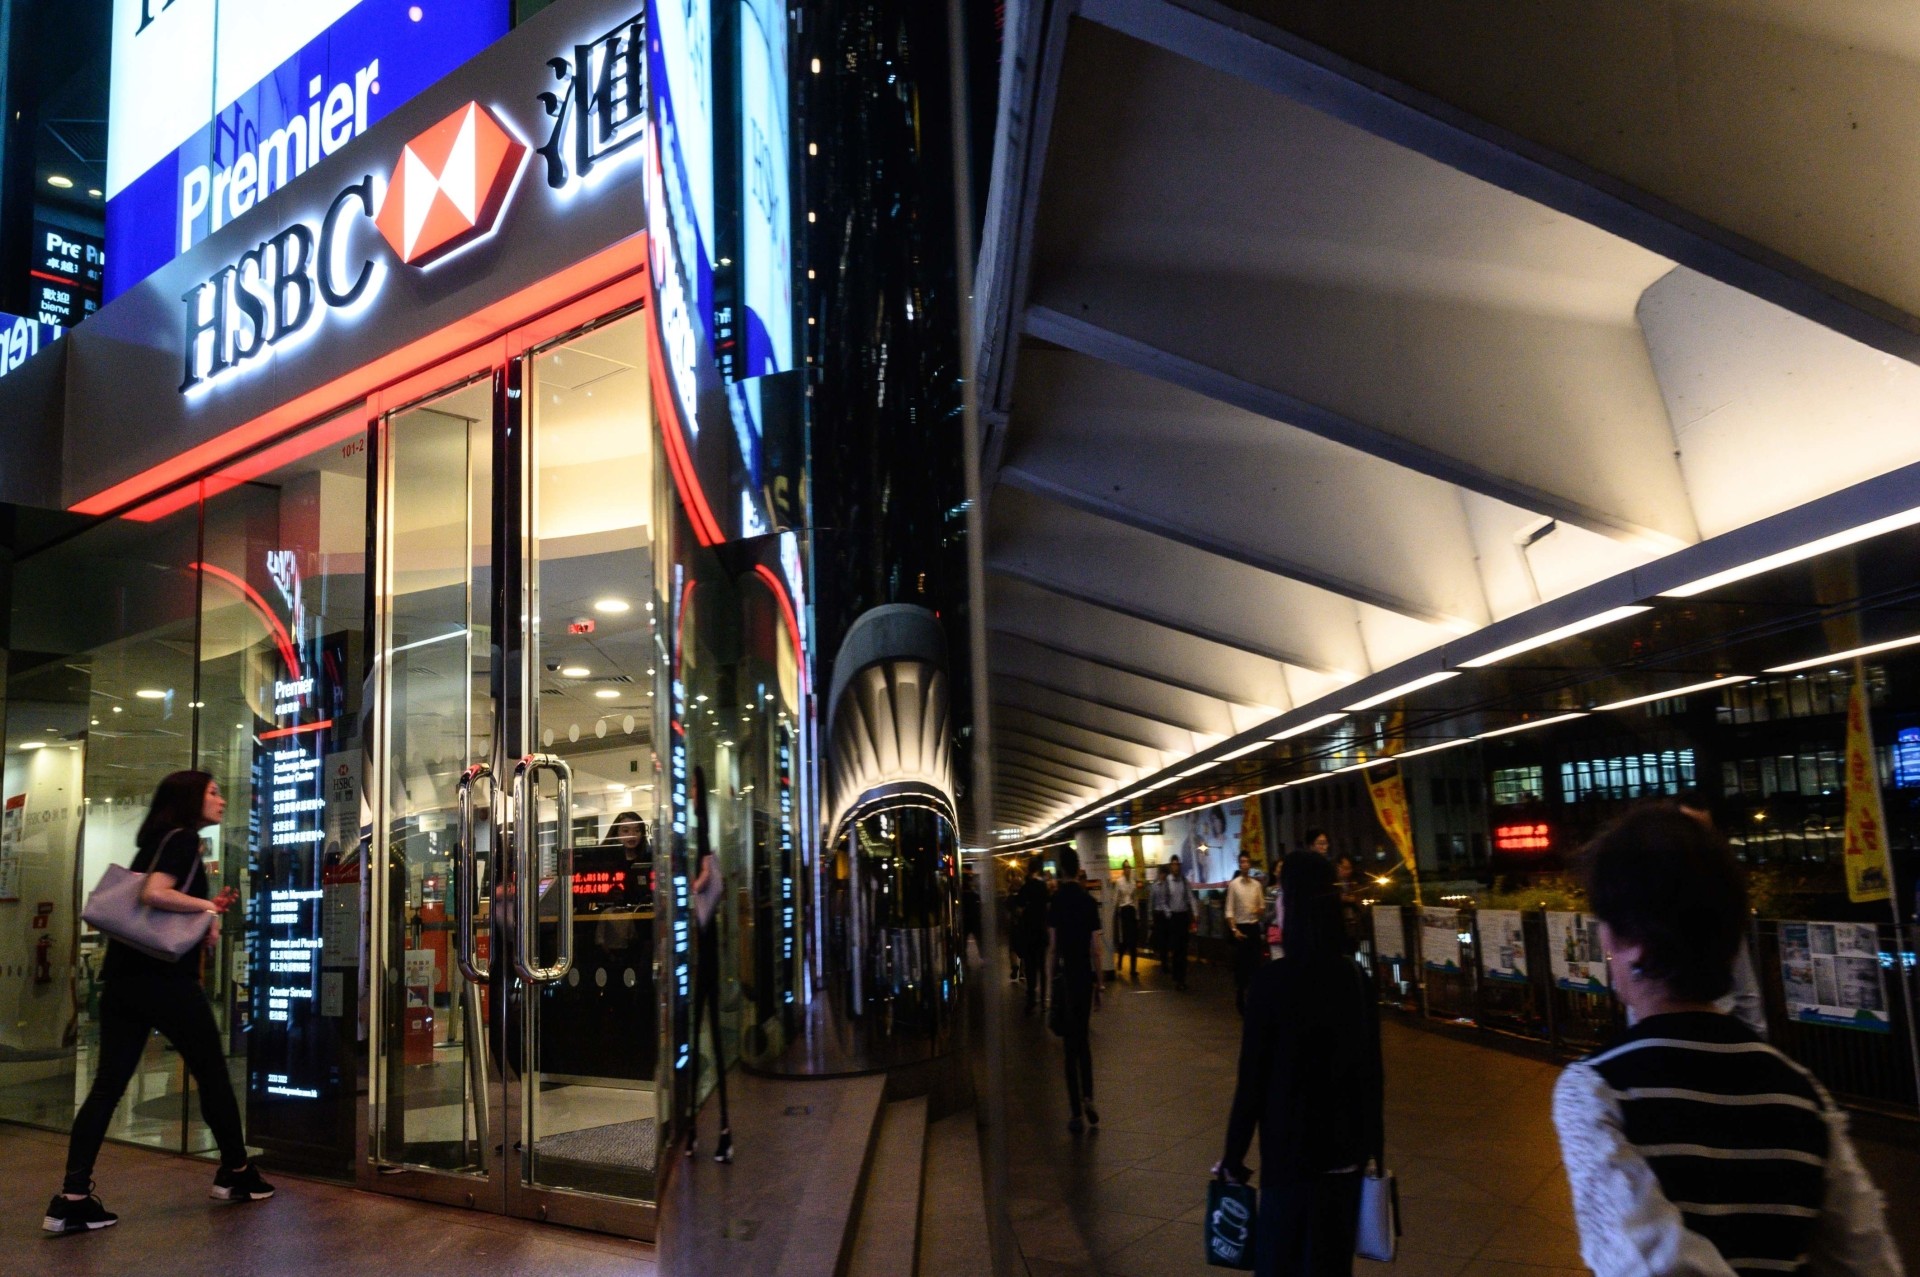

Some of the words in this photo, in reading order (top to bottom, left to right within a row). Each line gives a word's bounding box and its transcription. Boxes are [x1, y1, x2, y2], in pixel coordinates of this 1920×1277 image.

[181, 58, 379, 254] Premier
[178, 174, 375, 394] HSBC
[342, 438, 364, 459] 101-2
[275, 675, 313, 700] Premier
[333, 776, 354, 791] HSBC
[269, 986, 290, 997] Counter
[290, 987, 312, 998] Services
